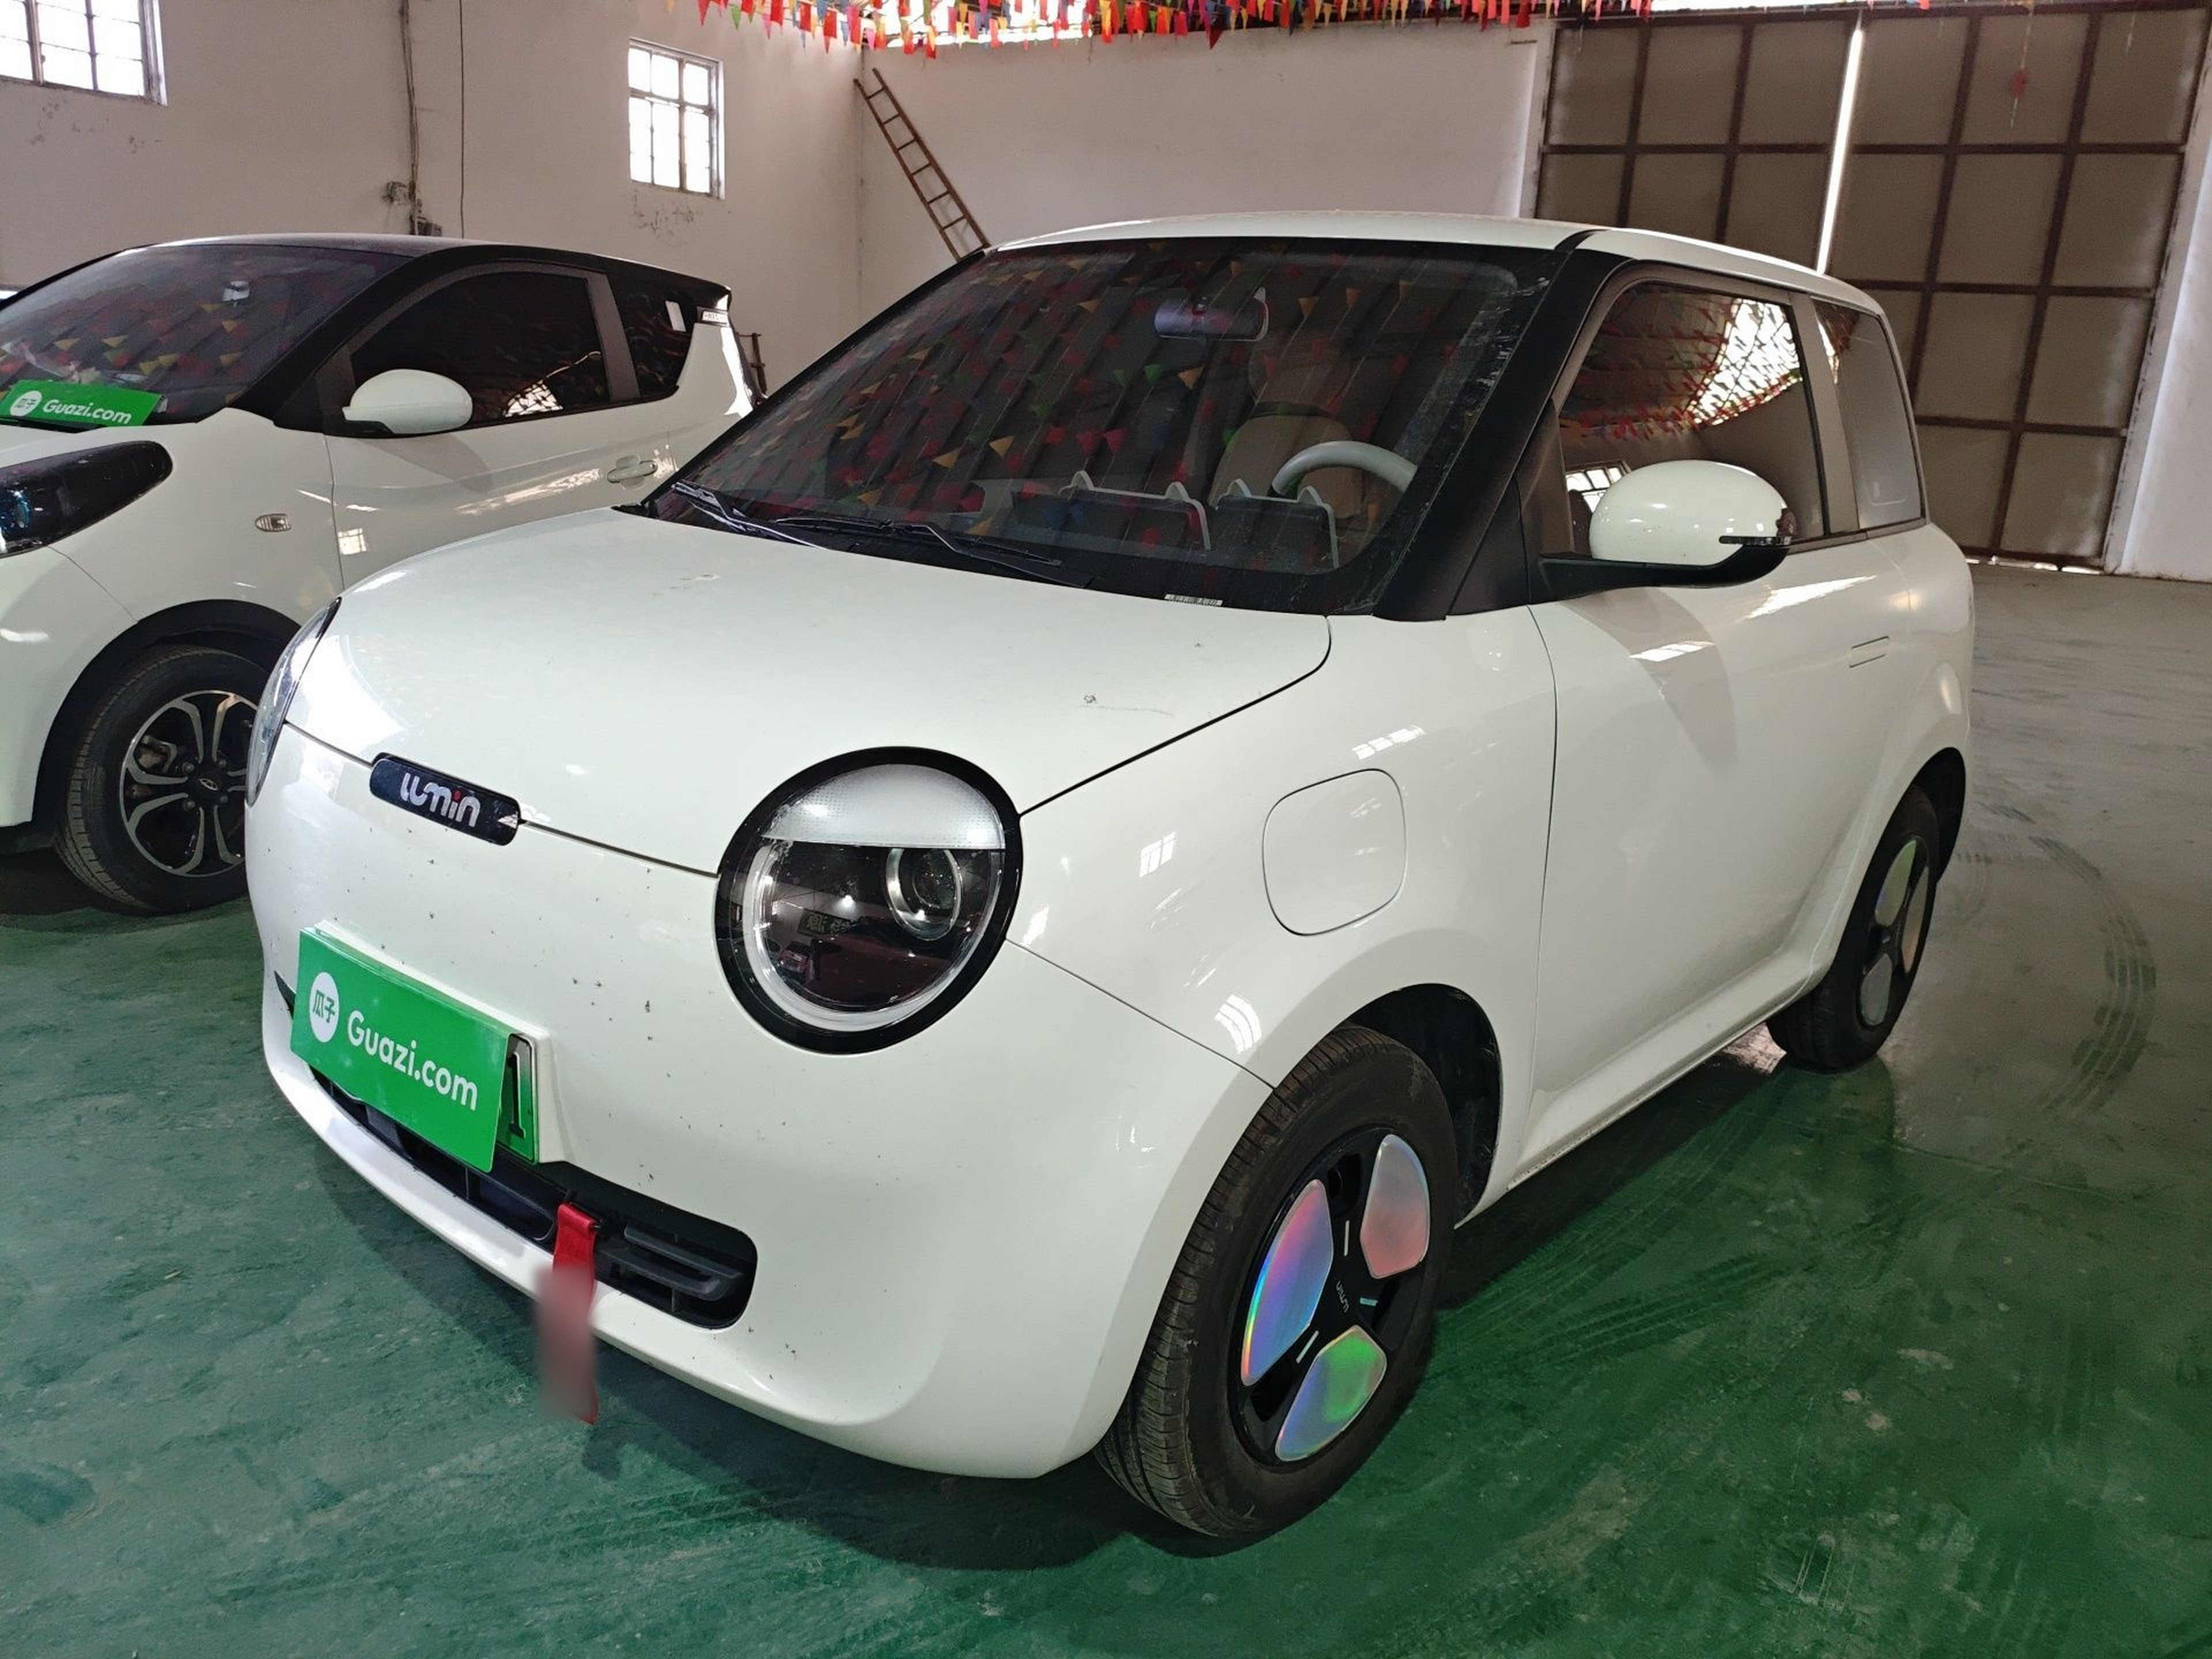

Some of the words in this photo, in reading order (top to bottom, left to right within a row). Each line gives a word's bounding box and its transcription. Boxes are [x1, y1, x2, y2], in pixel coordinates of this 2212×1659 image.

[43, 399, 132, 424] Guazi.com
[312, 989, 336, 1024] 瓜子
[347, 1009, 478, 1111] Guazi.com
